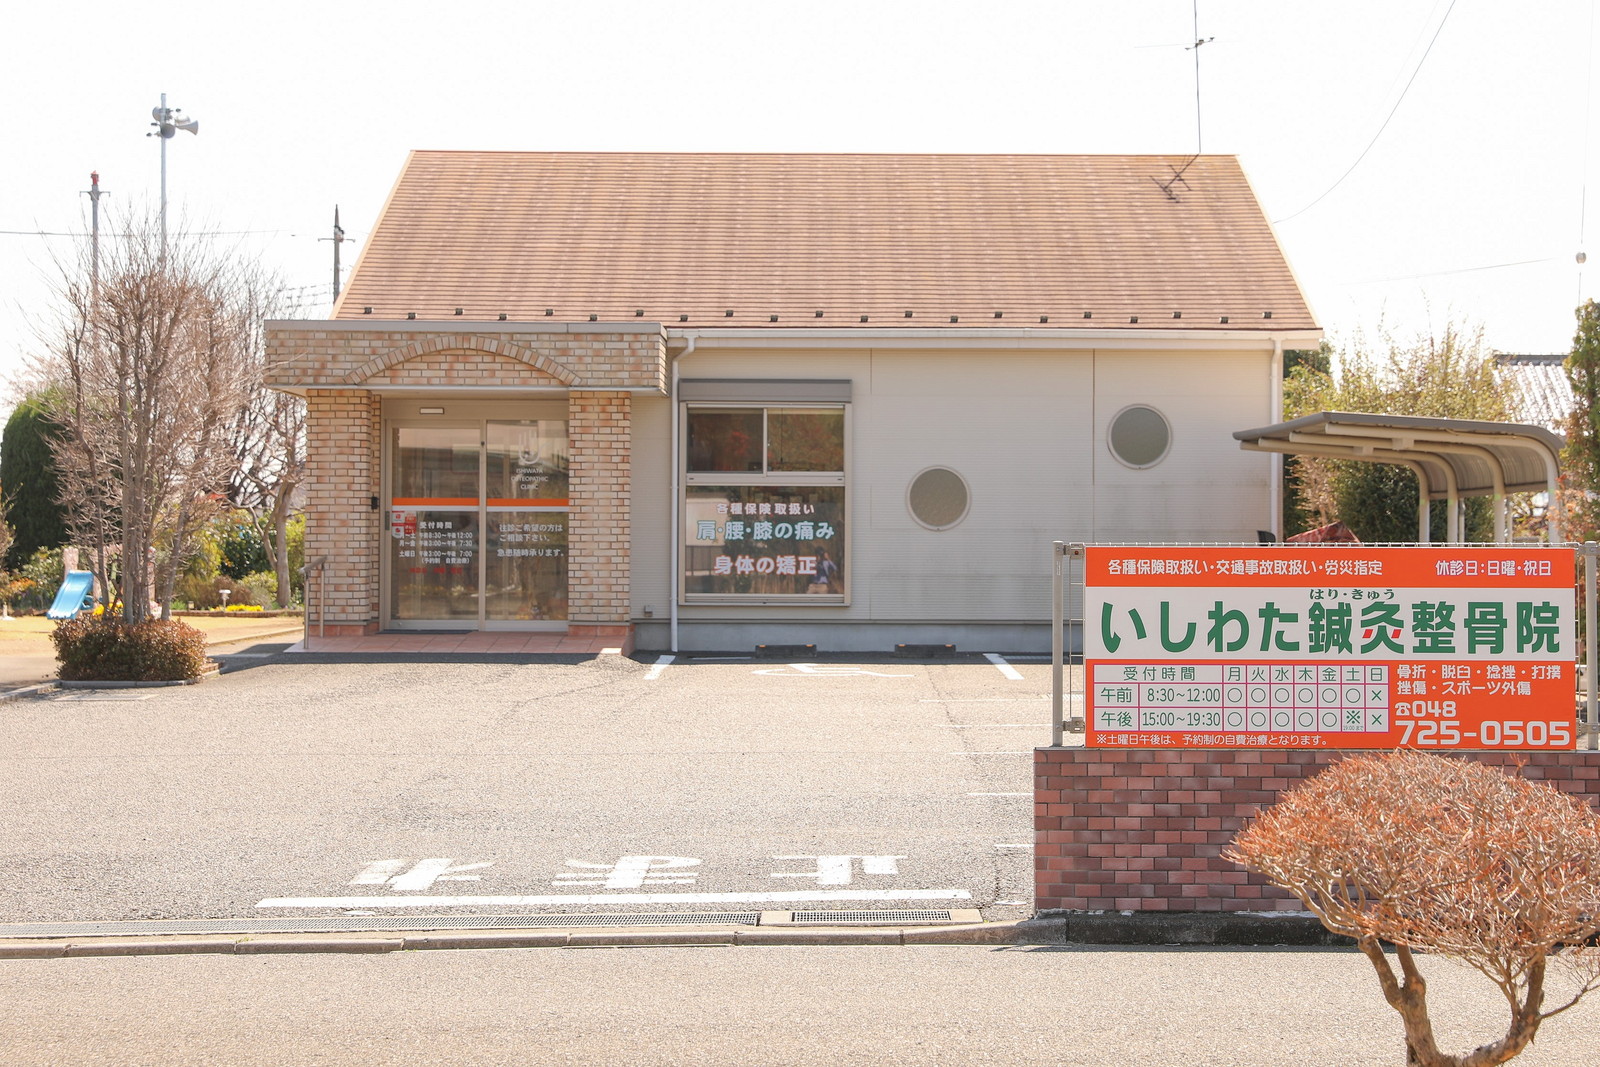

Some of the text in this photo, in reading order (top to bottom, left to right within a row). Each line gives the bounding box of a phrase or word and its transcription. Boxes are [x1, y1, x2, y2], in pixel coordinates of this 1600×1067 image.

[716, 503, 815, 515] 各種保険取扱い
[419, 521, 453, 529] 受付時間
[696, 520, 835, 540] 肩・腰・膝の痛み
[714, 555, 817, 575] 身体の矯正
[1310, 588, 1395, 601] はり・きゅう
[1101, 601, 1560, 654] いしわた鍼灸整骨院
[1123, 666, 1382, 681] 受付時間 月 火 水 木 金 土 日
[1101, 687, 1132, 703] 午前
[1412, 701, 1457, 717] 048
[1101, 711, 1133, 727] 午後
[1395, 720, 1570, 746] 725-0505
[347, 855, 907, 890] 止まれ
